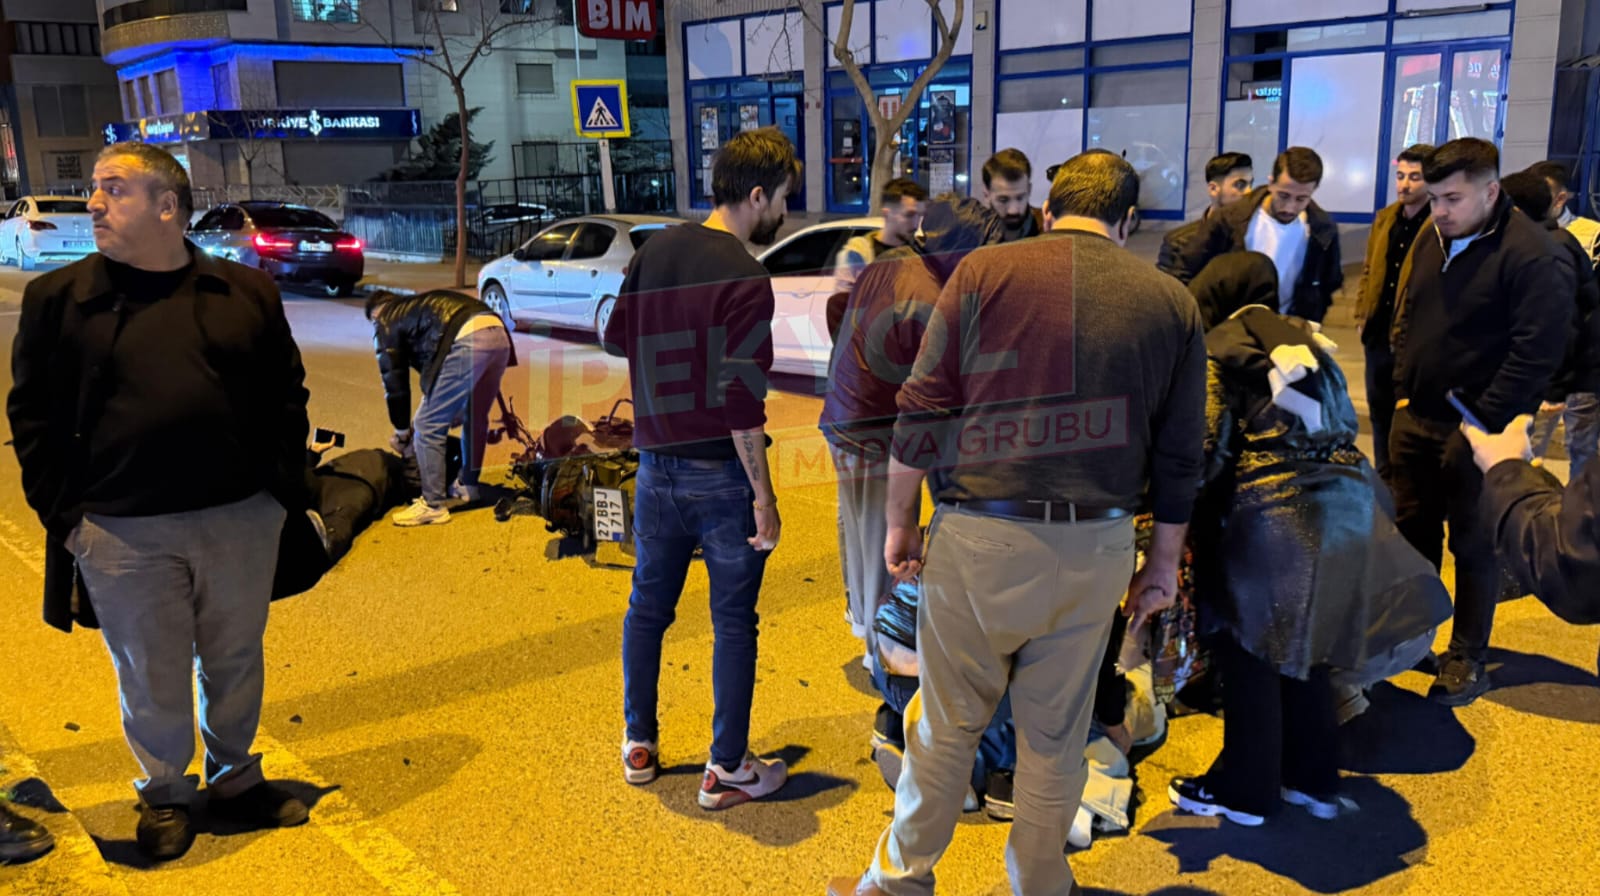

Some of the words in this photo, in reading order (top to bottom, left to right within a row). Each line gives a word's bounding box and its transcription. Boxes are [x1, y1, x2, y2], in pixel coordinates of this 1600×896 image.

[322, 116, 380, 128] BANKASI
[609, 501, 622, 527] 717
[597, 519, 609, 537] 27
